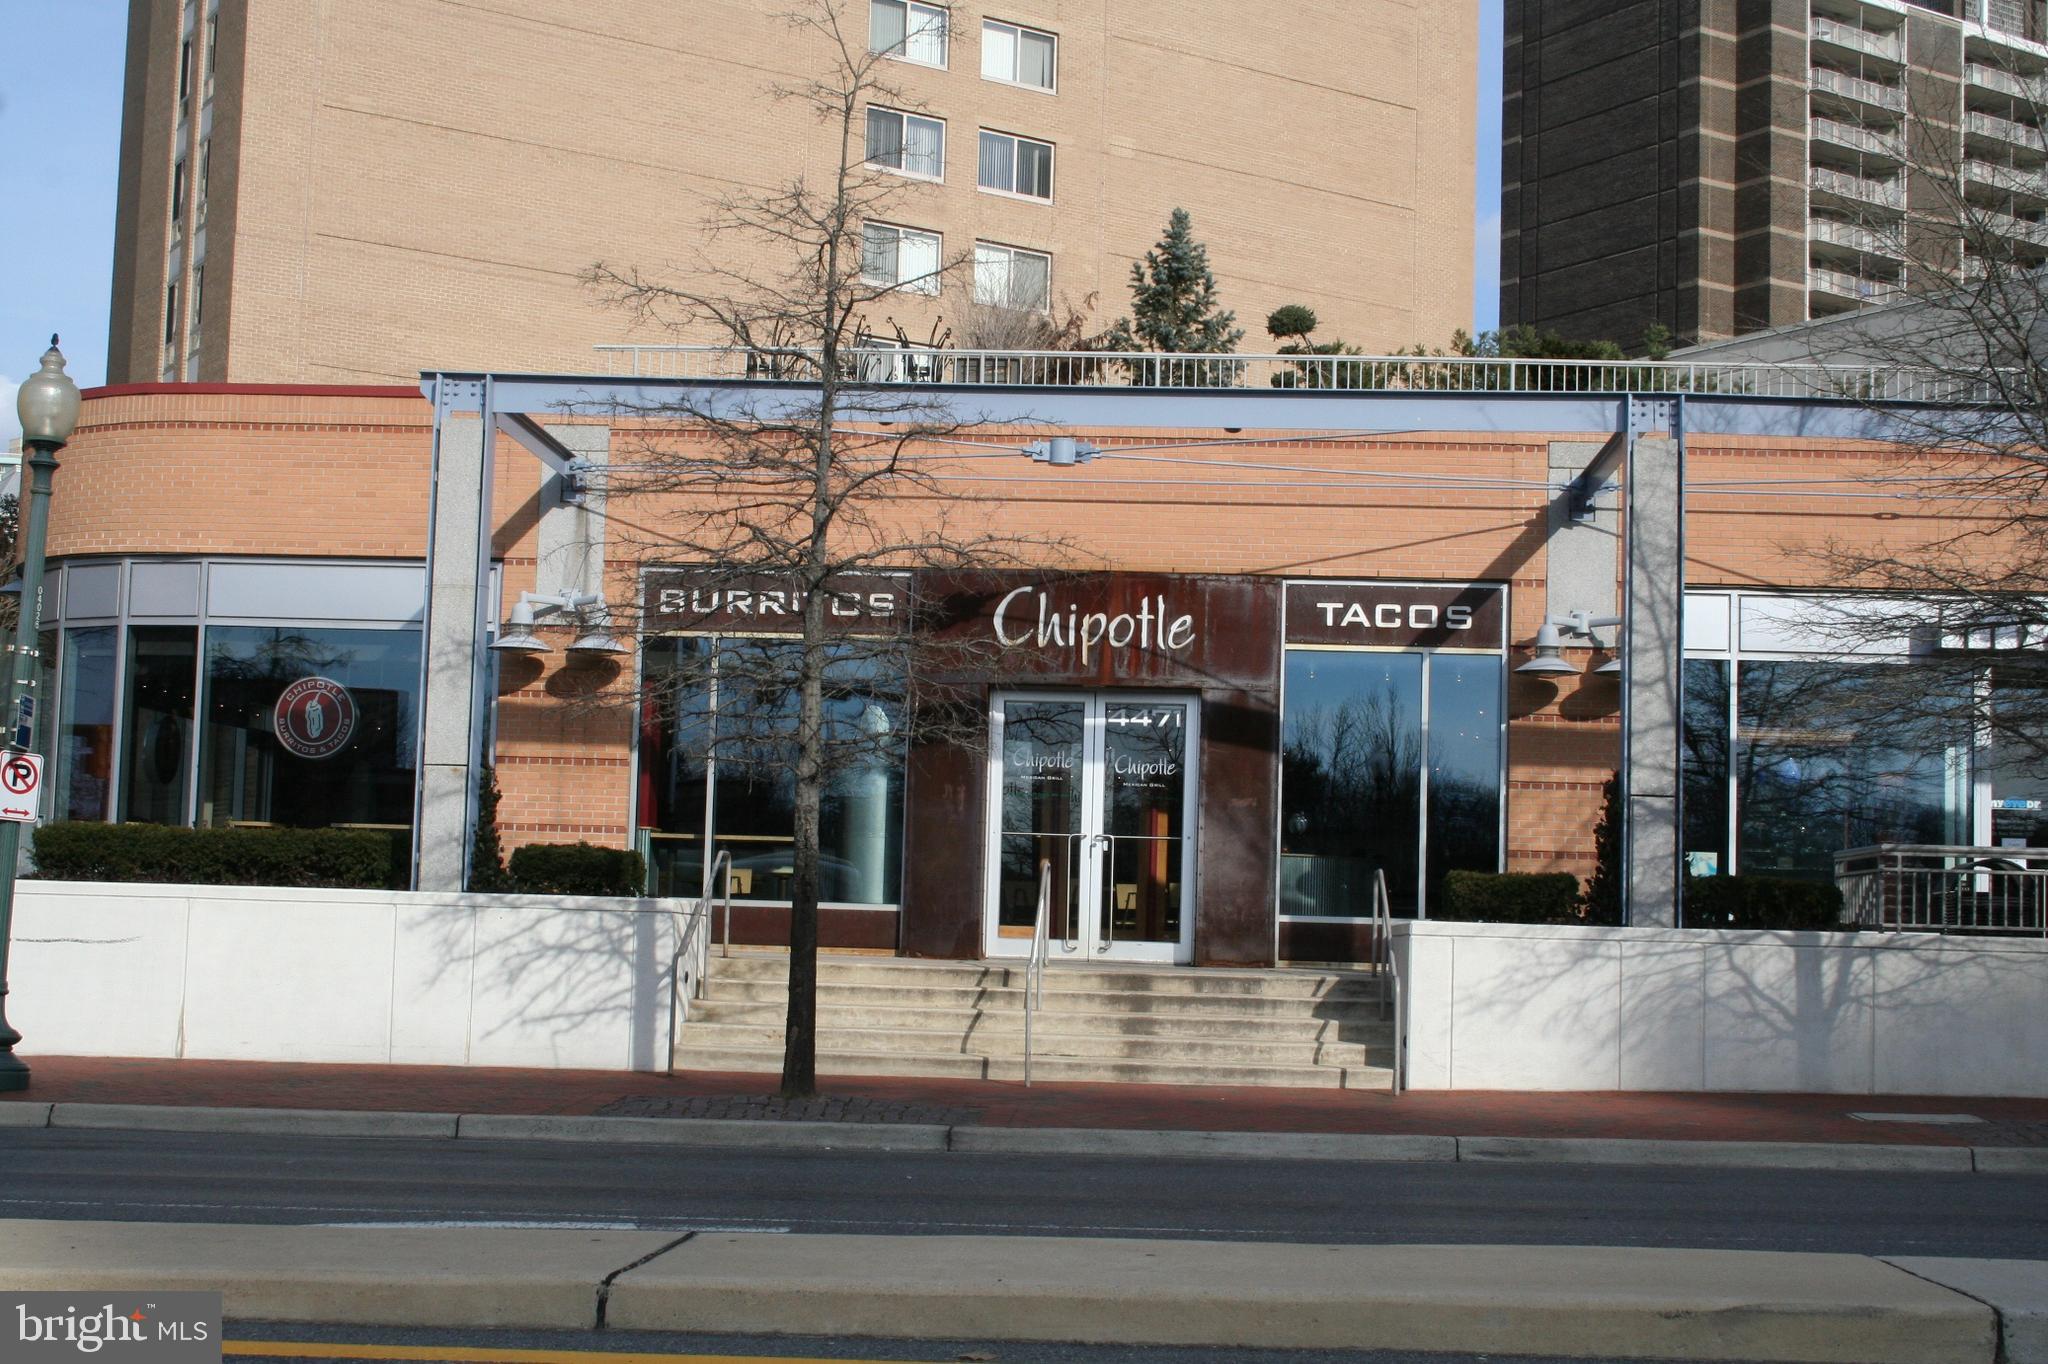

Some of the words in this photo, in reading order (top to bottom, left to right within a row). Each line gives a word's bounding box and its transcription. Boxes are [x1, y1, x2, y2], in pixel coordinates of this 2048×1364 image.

[660, 589, 895, 617] BURRIOS
[1316, 602, 1473, 630] TACOS
[993, 585, 1196, 667] Chipotle
[285, 681, 346, 702] CHIPOTLE
[1107, 708, 1182, 728] 4471
[1013, 747, 1073, 773] Chipotle
[1114, 754, 1177, 780] Chipotle
